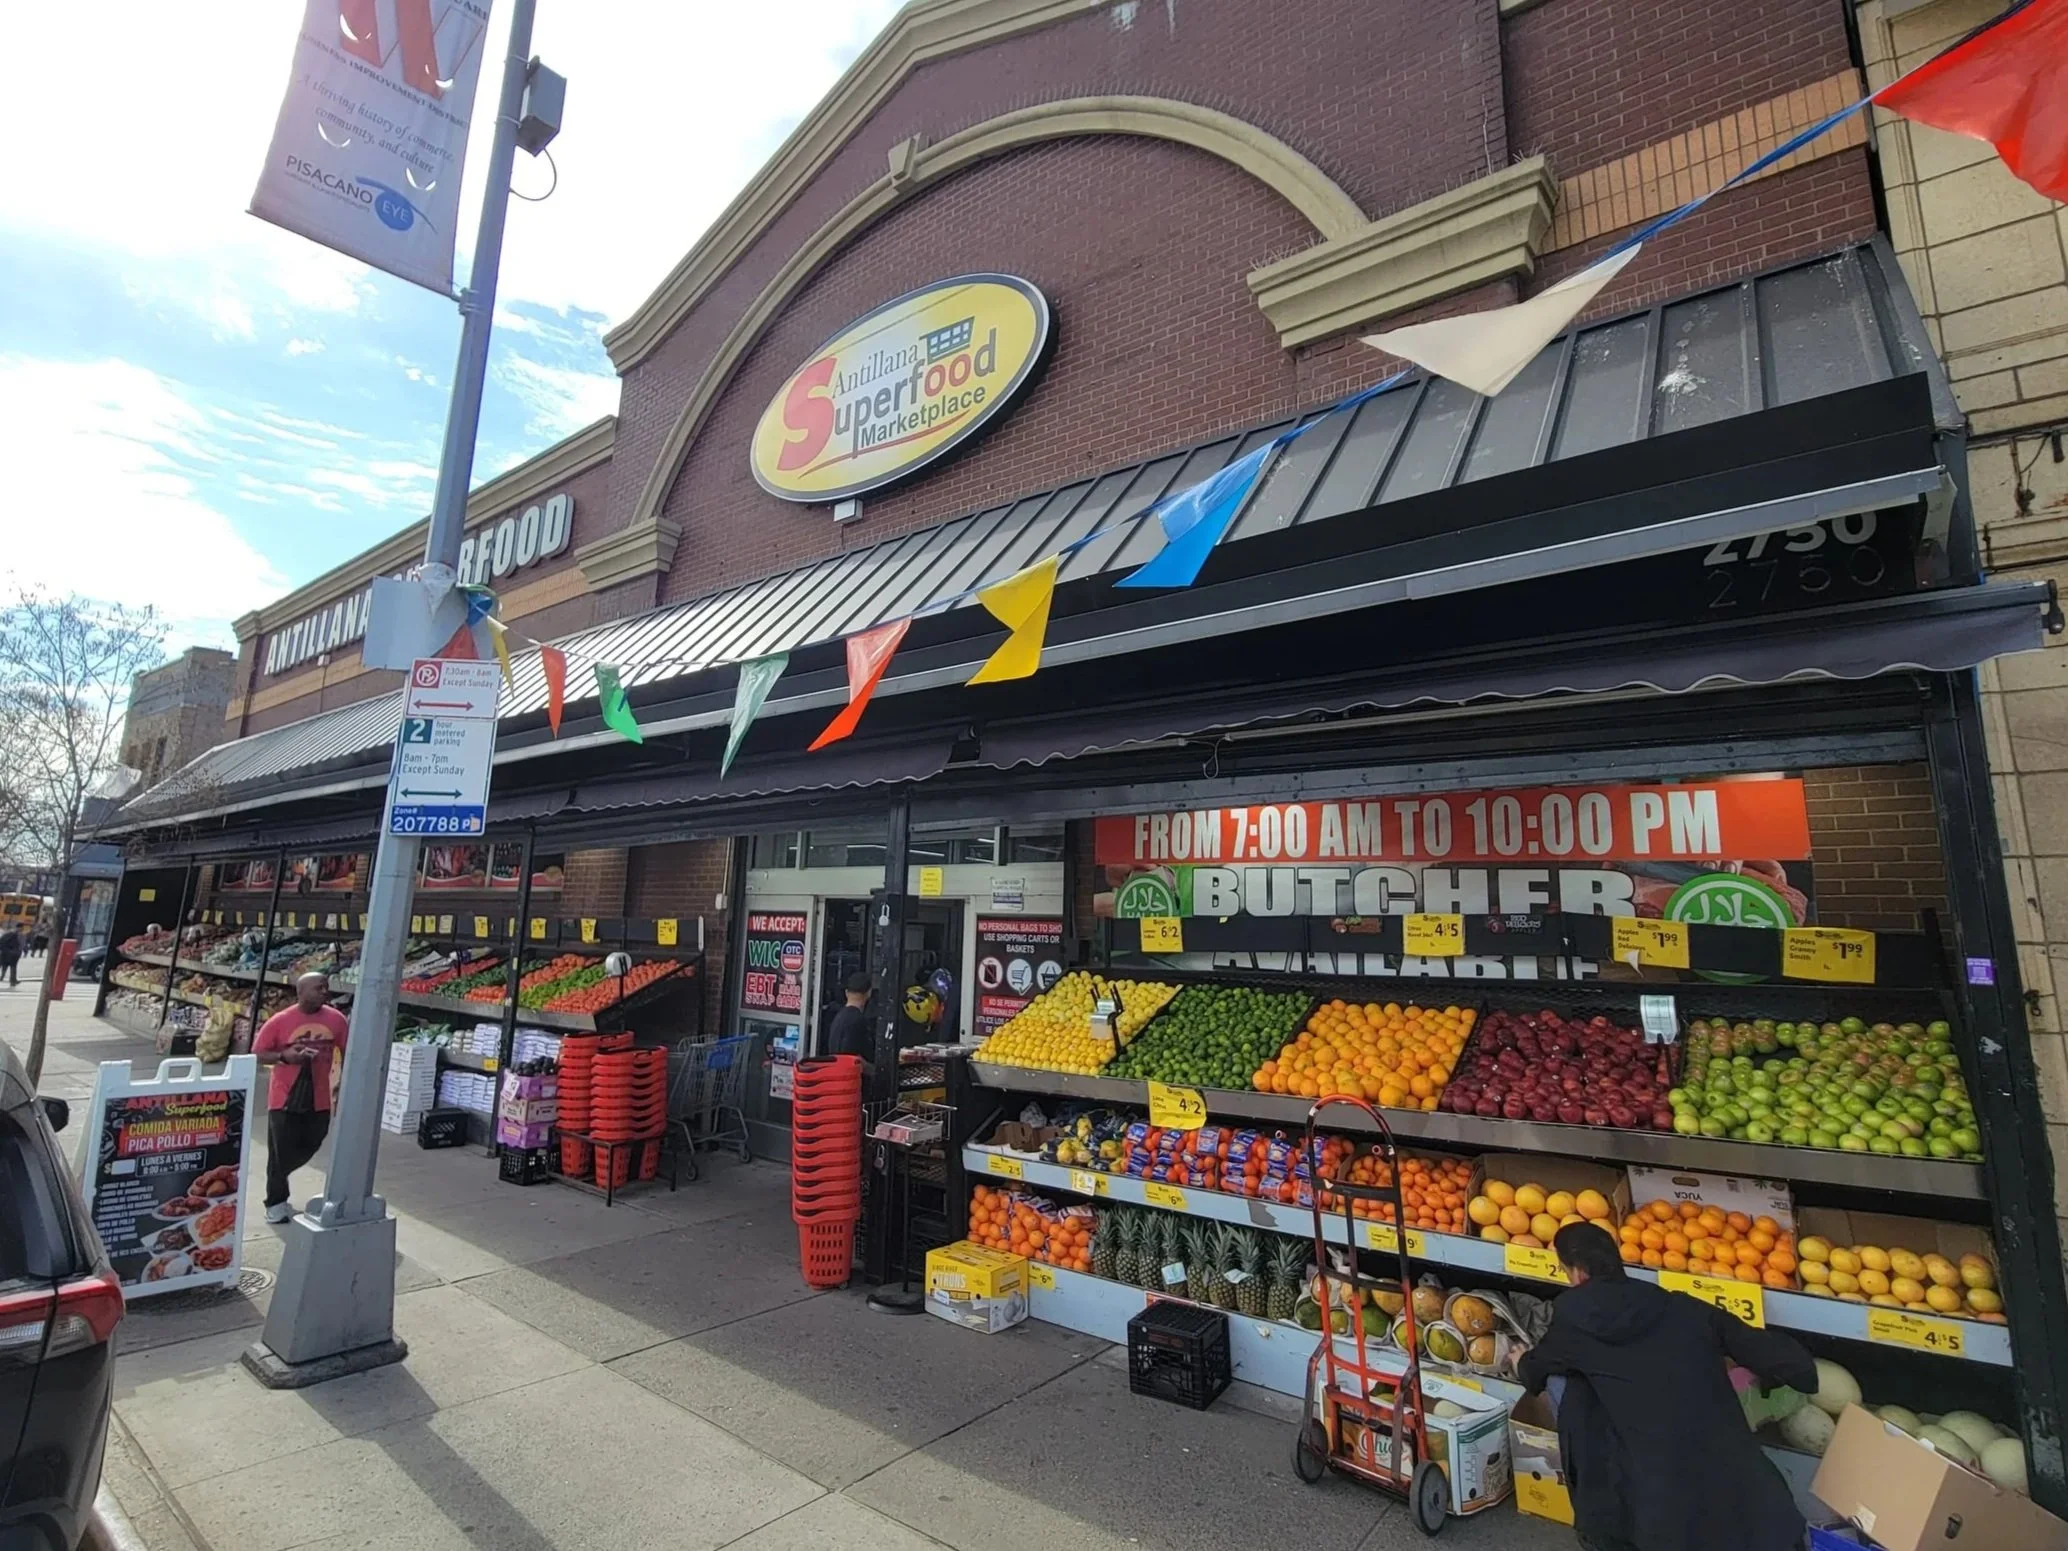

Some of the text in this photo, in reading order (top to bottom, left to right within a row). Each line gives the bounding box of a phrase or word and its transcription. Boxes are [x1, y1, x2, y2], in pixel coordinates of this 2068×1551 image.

[349, 61, 426, 107] IMPROVEMENT
[427, 102, 468, 129] DISTRIC
[314, 78, 357, 115] thriving
[358, 101, 395, 133] history
[395, 125, 409, 143] of
[315, 106, 436, 175] community, and culture
[285, 154, 374, 205] PISACANO
[382, 199, 410, 224] EYE
[832, 342, 919, 399] Antillana
[776, 327, 997, 472] Superfood
[861, 385, 986, 450] Marketplace
[263, 587, 373, 678] ANTILLANA
[442, 677, 494, 689] Except Sunday
[409, 719, 427, 742] 2
[434, 729, 466, 737] metered
[433, 737, 461, 746] parking
[404, 753, 422, 763] 8am
[431, 753, 448, 764] 7pm
[402, 764, 465, 777] Except Sunday
[392, 816, 459, 832] 207788
[1135, 789, 1722, 860] FROM 7:00 AM TO 10:00 PM
[1192, 866, 1636, 918] BUTCHER
[752, 915, 805, 933] WE ACCEPT:
[978, 922, 987, 931] NO
[988, 922, 1020, 932] PERSONAL
[1020, 924, 1038, 933] BAGS
[1039, 924, 1047, 933] TO
[1617, 928, 1640, 936] Apples
[983, 932, 1060, 944] USE SHOPPING CARTS OR
[1789, 937, 1816, 946] Apples
[747, 939, 802, 969] WIC OTC
[1006, 943, 1035, 954] BASKETS
[1617, 943, 1646, 951] Delicious
[1789, 945, 1817, 955] Granny
[1789, 953, 1812, 961] Smith
[746, 972, 777, 995] EBT
[744, 993, 776, 1007] SNAP
[165, 1101, 228, 1116] Superfood
[129, 1115, 220, 1136] COMIDA VARIADA
[128, 1136, 154, 1153] PICA
[156, 1133, 192, 1150] POLLO
[141, 1151, 202, 1167] LUNES A VIERNES
[1674, 1191, 1703, 1202] YUCA
